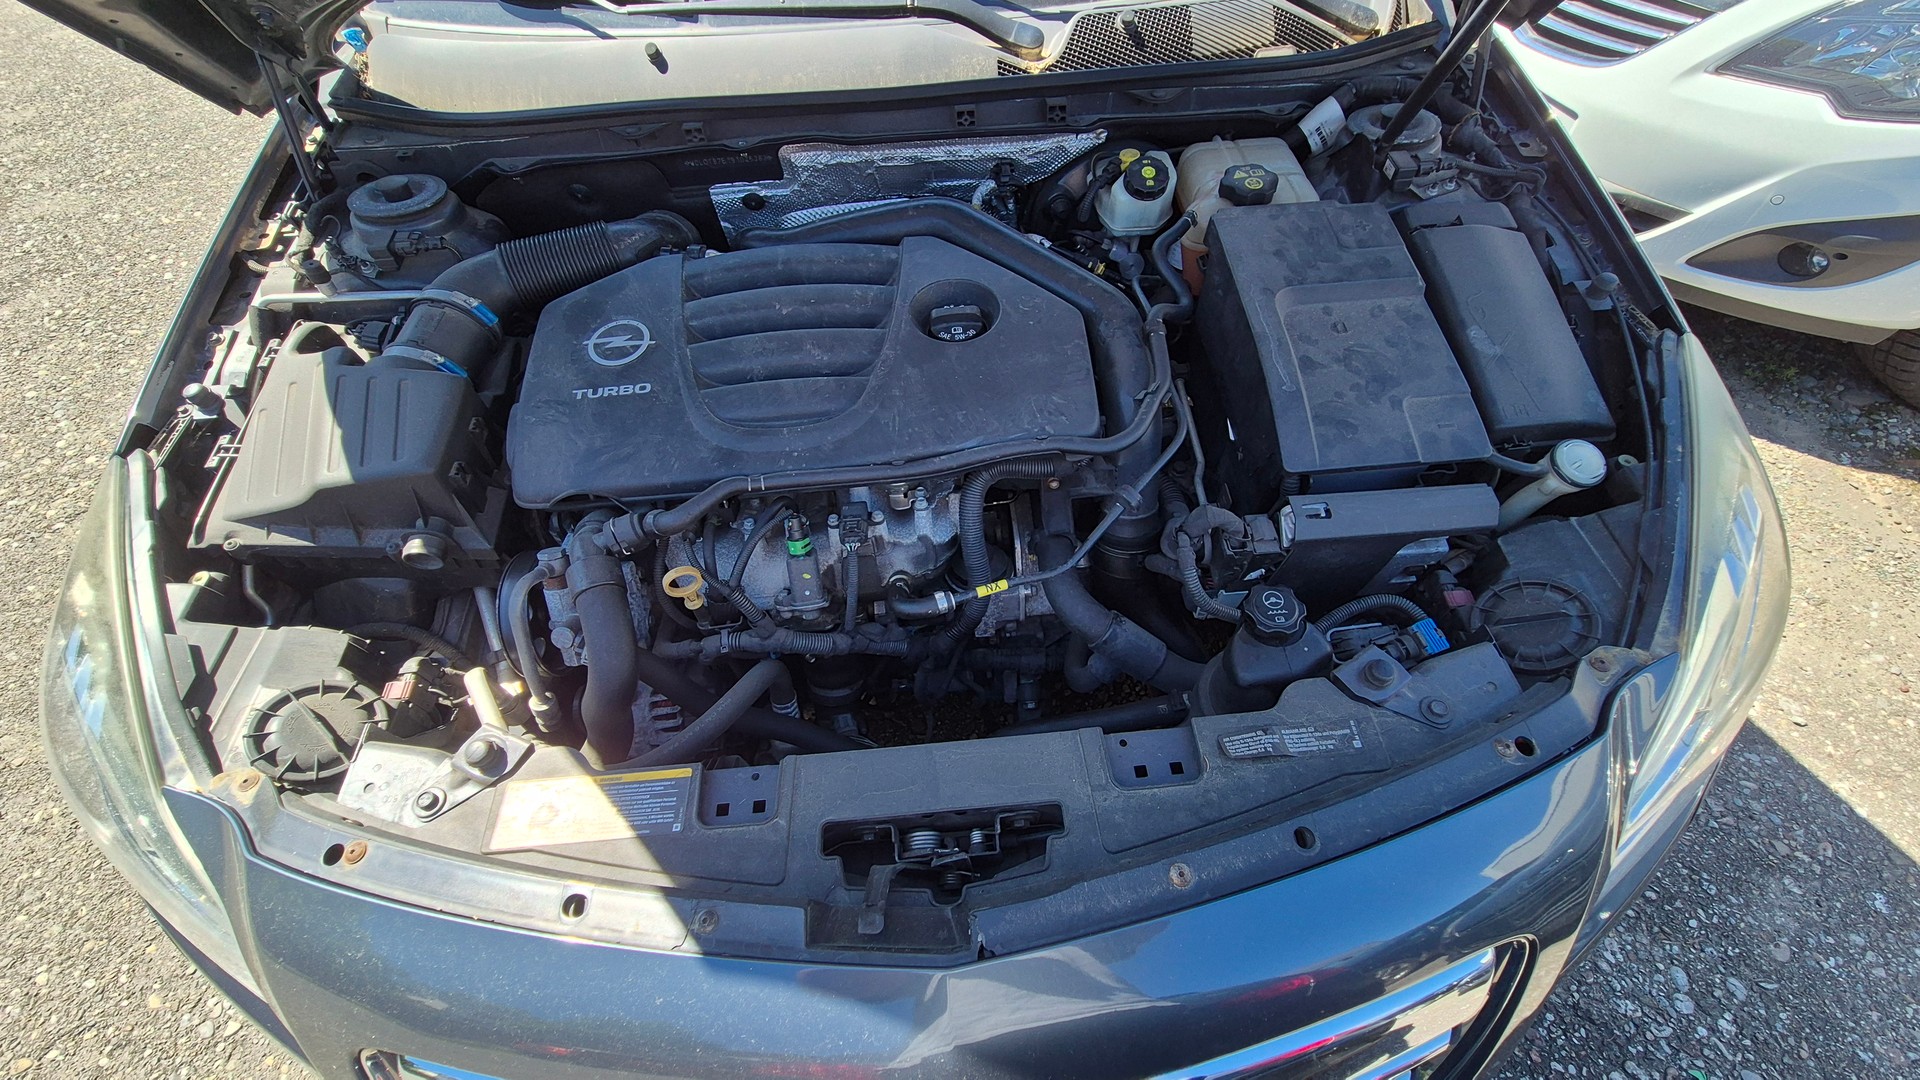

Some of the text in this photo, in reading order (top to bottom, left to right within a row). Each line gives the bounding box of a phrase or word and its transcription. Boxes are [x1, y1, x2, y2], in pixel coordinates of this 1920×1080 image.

[938, 329, 976, 340] SAE 5W-30
[572, 383, 651, 399] TURBO
[985, 581, 1001, 592] NX
